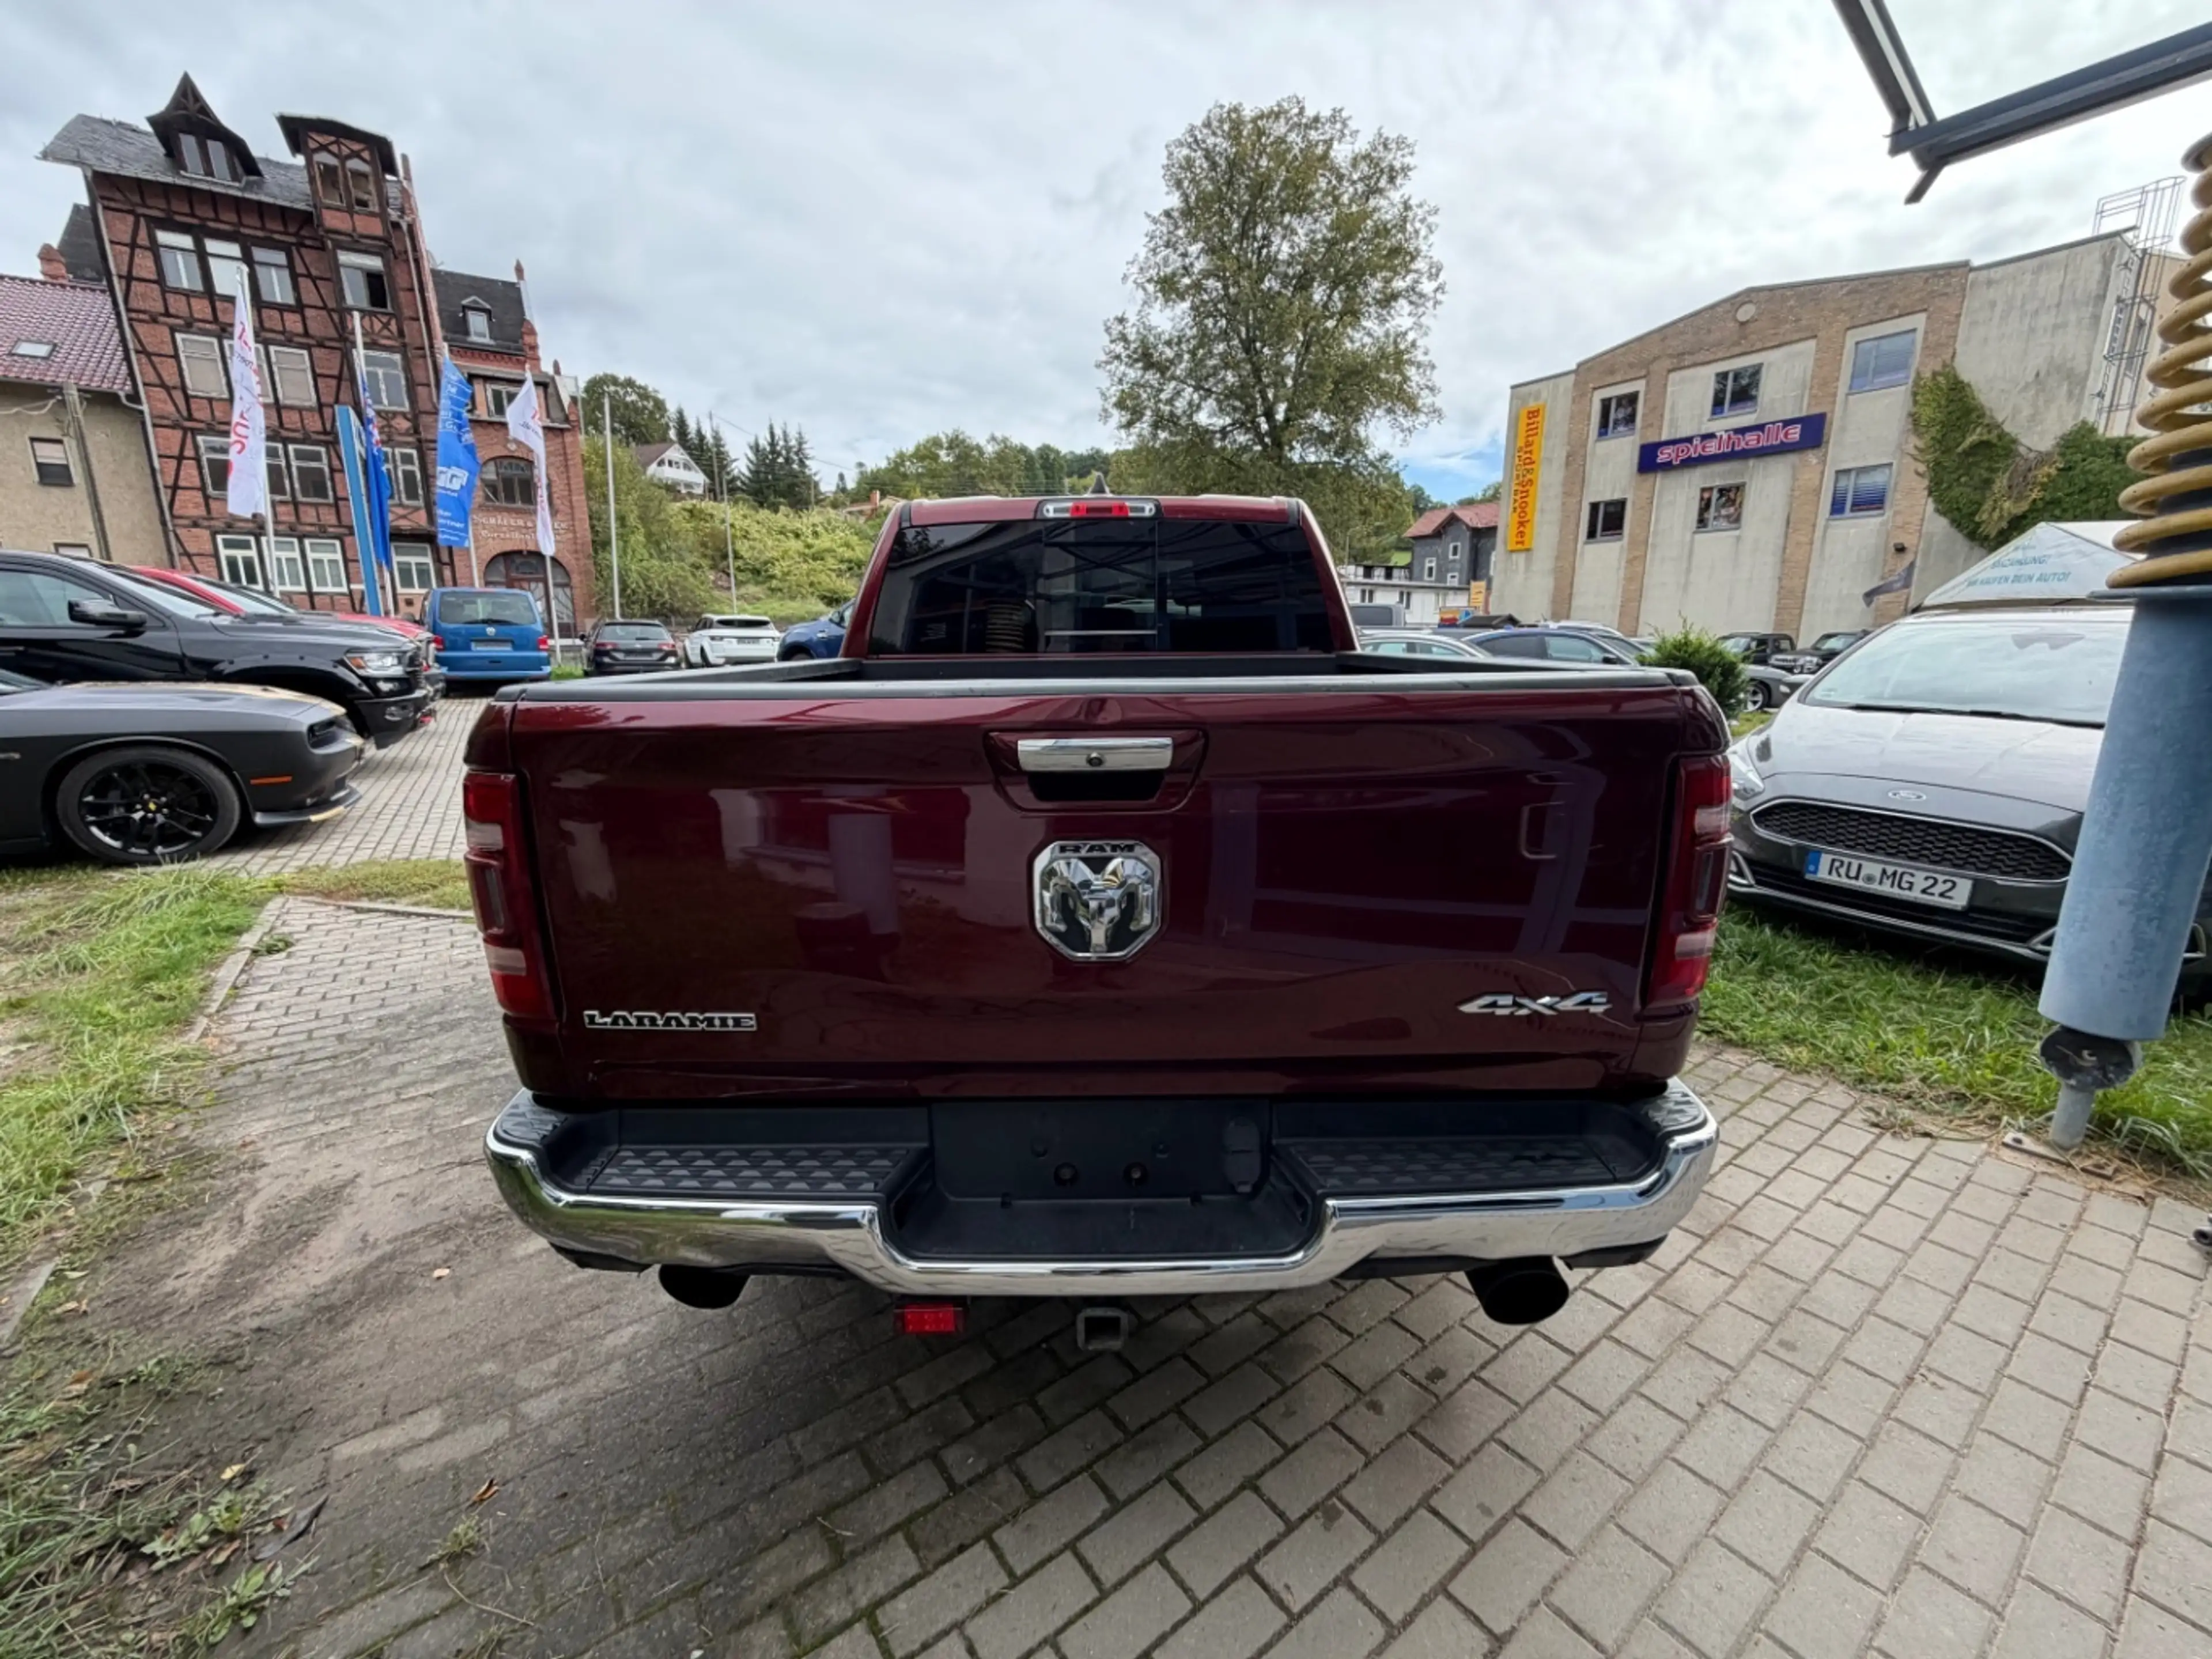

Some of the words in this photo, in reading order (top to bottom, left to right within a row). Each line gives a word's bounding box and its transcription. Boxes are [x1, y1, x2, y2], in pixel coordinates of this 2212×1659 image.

[1656, 422, 1802, 465] spielhalle
[1059, 843, 1136, 854] RAM
[1828, 858, 1863, 881] RU
[1878, 866, 1916, 892] MG
[1920, 876, 1957, 900] 22
[583, 1010, 758, 1031] LARAMIE
